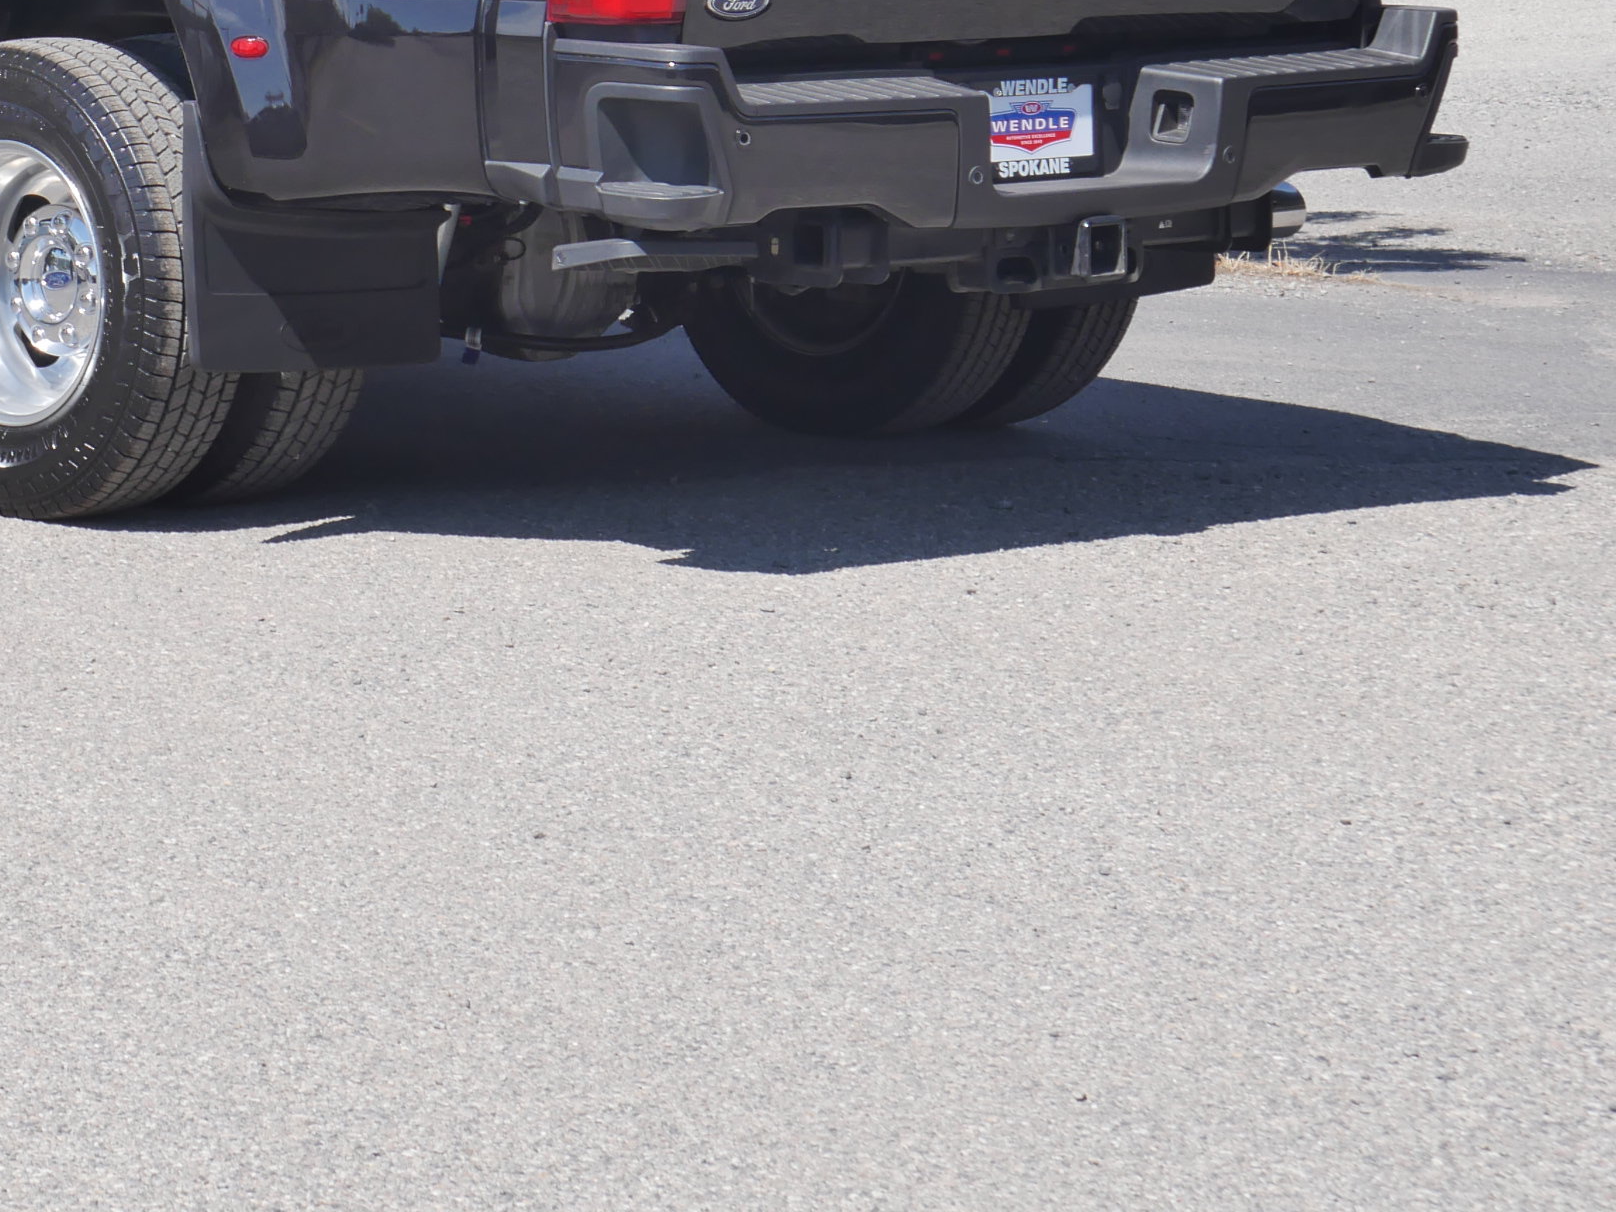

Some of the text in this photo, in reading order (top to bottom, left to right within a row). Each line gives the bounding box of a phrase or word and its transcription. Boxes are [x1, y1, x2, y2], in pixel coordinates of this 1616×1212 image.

[1000, 78, 1068, 96] WENDLE
[992, 116, 1070, 133] WENDLE
[998, 157, 1070, 178] SPOKANE
